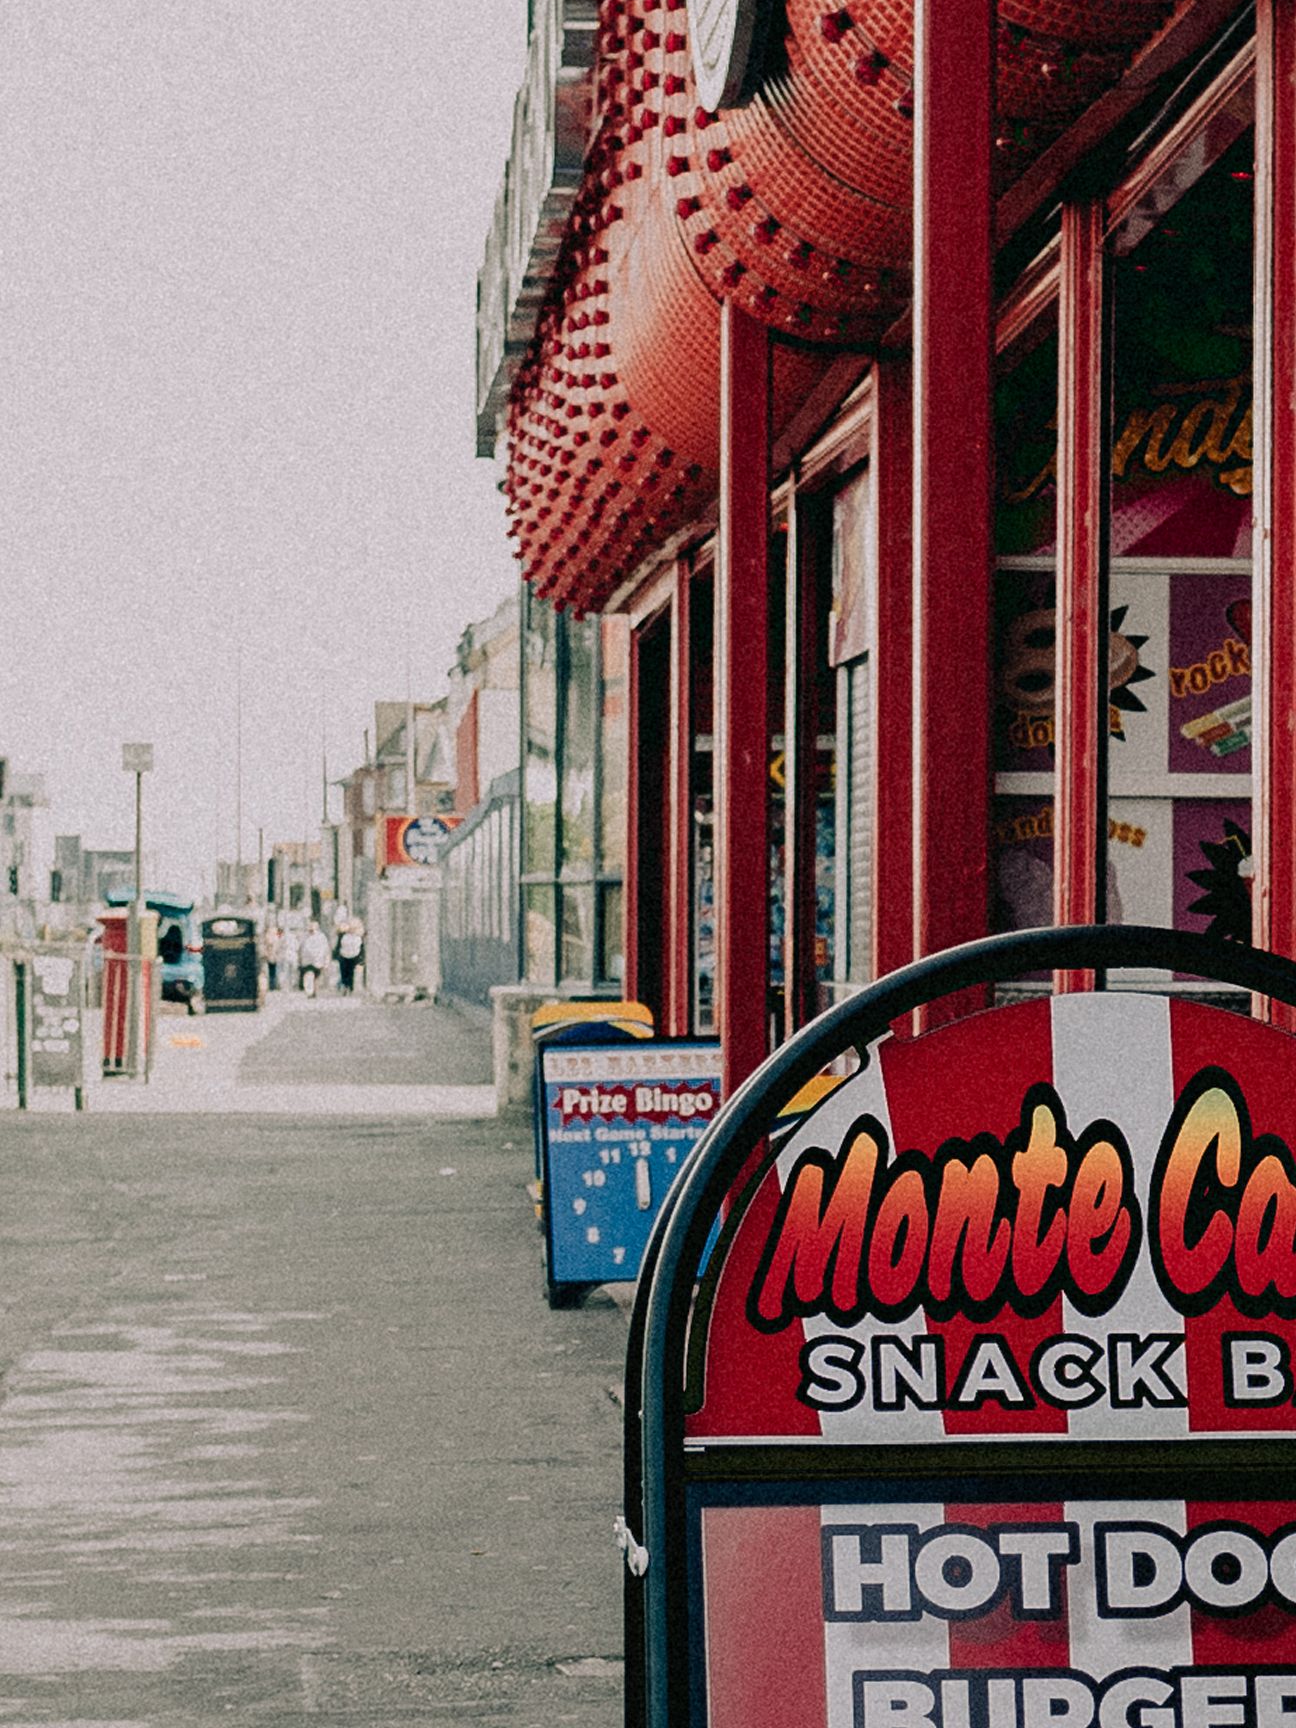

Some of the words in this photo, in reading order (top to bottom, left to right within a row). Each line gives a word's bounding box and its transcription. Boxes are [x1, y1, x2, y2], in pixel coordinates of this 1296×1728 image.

[549, 1128, 593, 1144] Next
[595, 1126, 648, 1142] Game
[562, 1087, 629, 1115] Prize
[634, 1086, 714, 1117] Bingo
[750, 1094, 1134, 1328] Monte
[801, 1331, 1187, 1411] SNACK
[828, 1524, 1075, 1619] HOT
